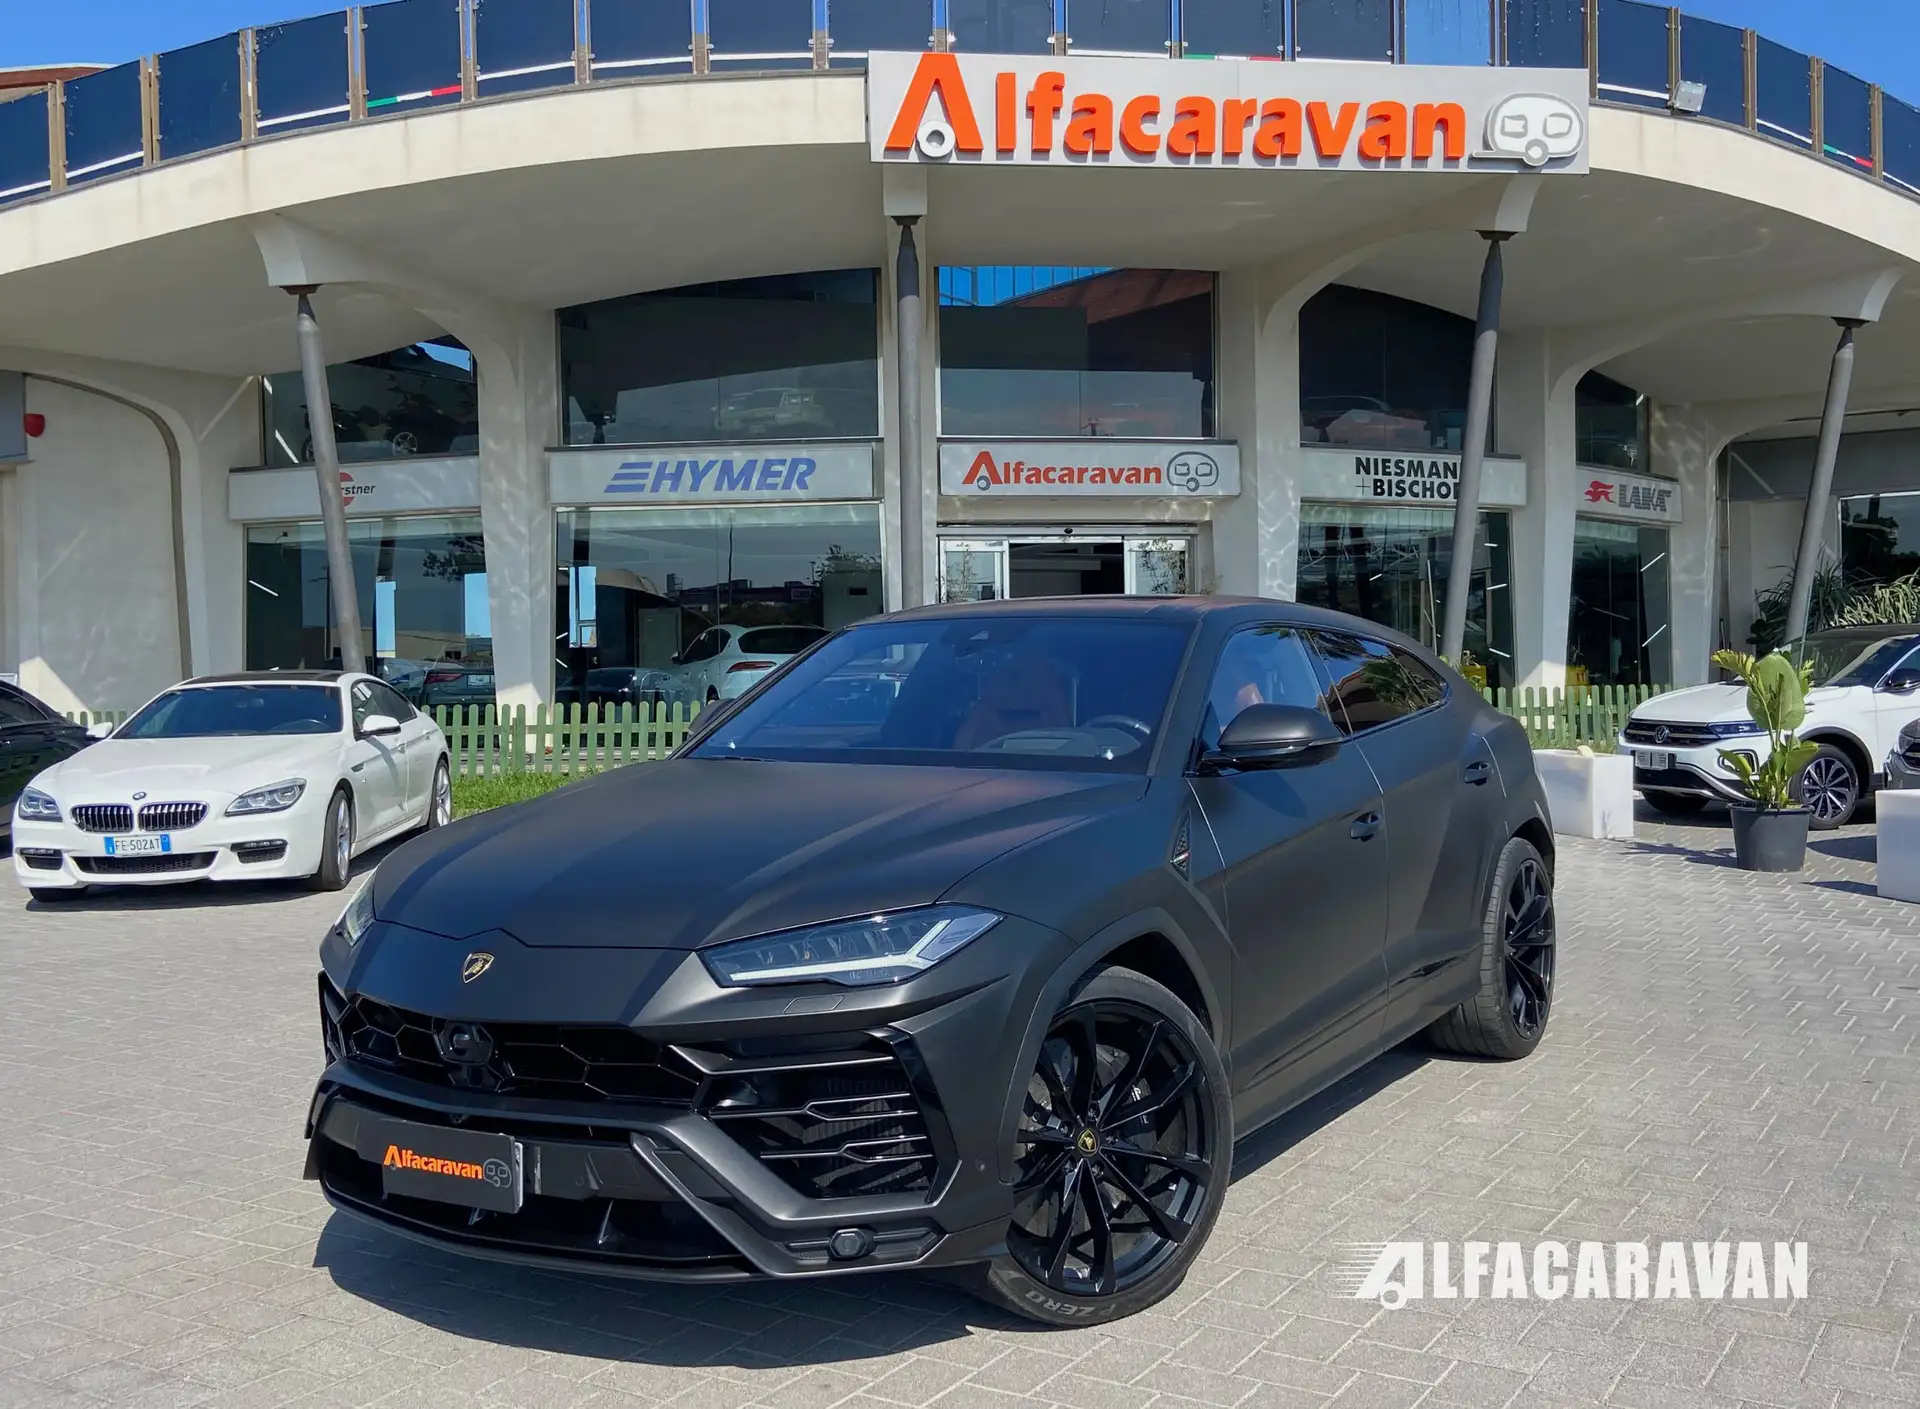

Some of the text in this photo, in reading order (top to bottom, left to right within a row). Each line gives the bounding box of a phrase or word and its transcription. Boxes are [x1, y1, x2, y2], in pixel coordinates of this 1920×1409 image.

[884, 51, 1466, 160] Alfacaravan
[650, 457, 816, 493] HYMER
[962, 450, 1162, 485] Alfacaravan
[1355, 456, 1461, 480] NIESMAN
[383, 1144, 483, 1180] Alfacaravan
[1025, 1290, 1097, 1318] ZERO
